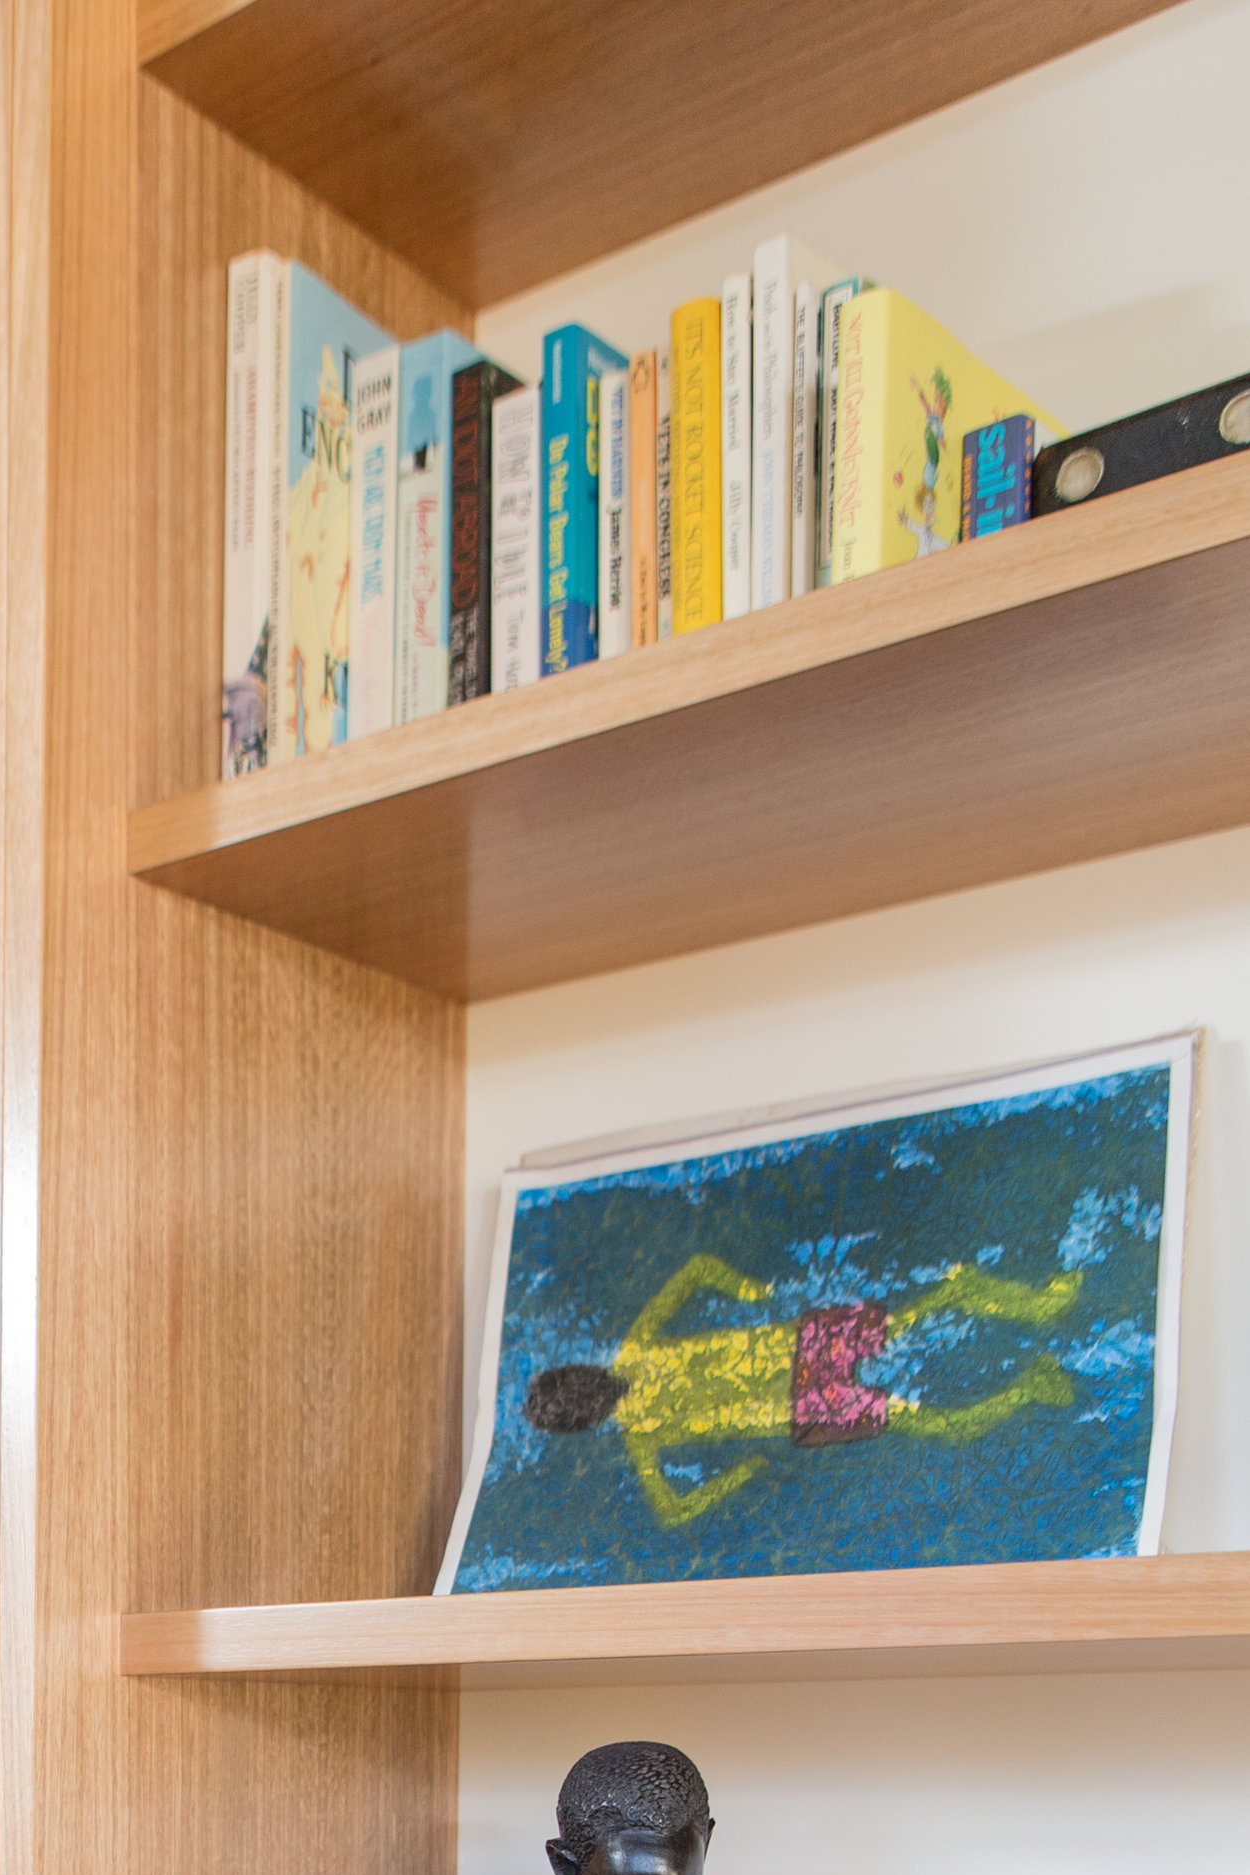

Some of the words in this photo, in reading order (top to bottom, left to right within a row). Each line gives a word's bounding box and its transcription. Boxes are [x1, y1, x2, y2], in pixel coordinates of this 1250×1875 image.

[845, 311, 863, 357] NOT
[357, 375, 391, 408] JOHN
[684, 364, 704, 417] NOT
[356, 403, 392, 436] GRAY
[497, 403, 534, 485] HOW
[725, 390, 740, 452] Married
[548, 434, 570, 463] Do
[684, 423, 704, 516] ROCKET
[547, 463, 570, 513] Polar
[725, 480, 741, 516] Jilly
[547, 514, 570, 569] Bears
[725, 519, 741, 572] Cooper
[547, 572, 569, 602] Get
[684, 527, 704, 624] SCIENCE
[544, 602, 569, 674] Lonely?
